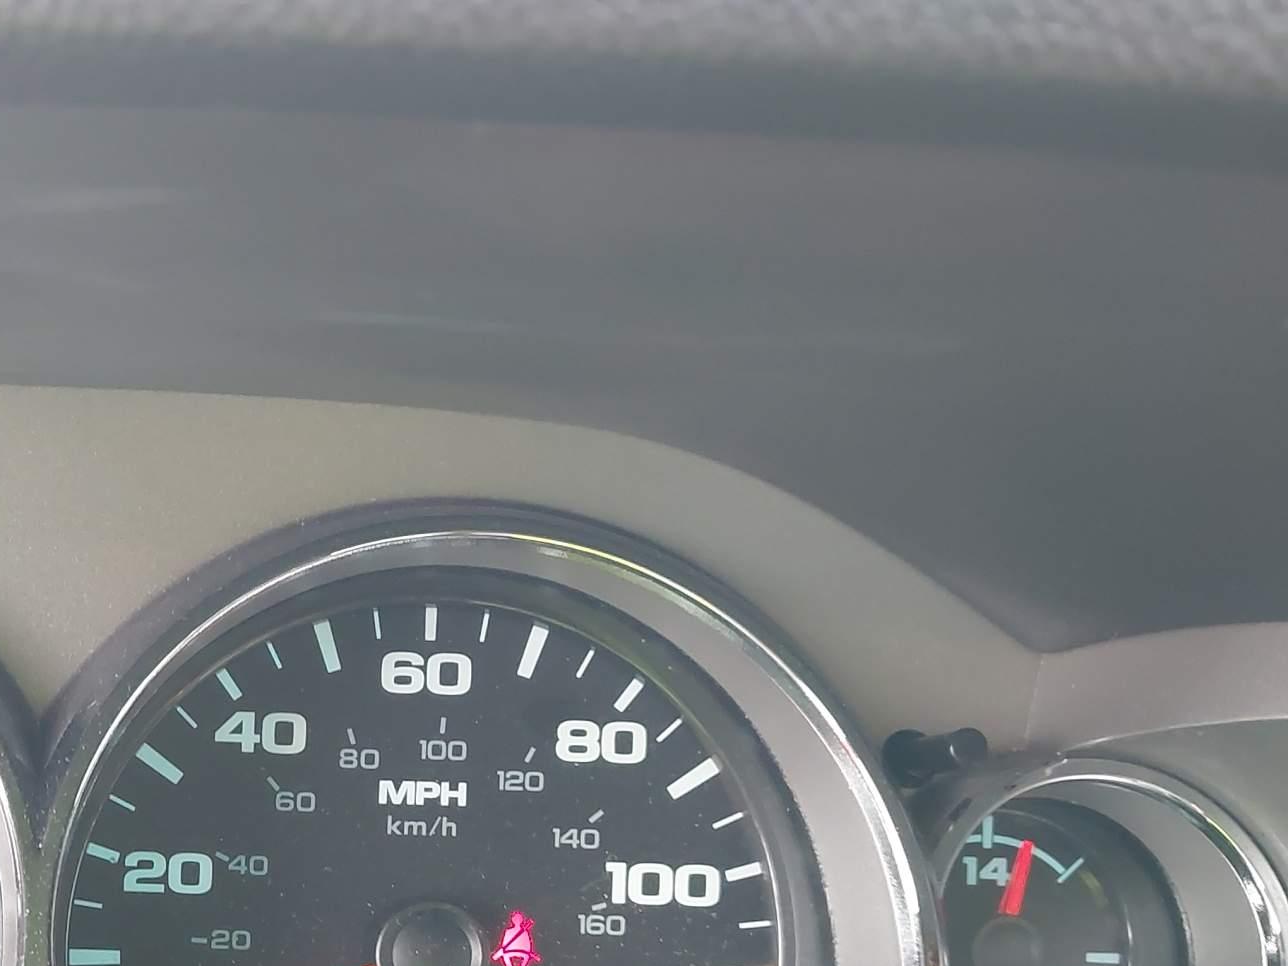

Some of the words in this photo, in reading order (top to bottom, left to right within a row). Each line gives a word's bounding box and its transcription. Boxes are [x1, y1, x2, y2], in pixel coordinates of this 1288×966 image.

[380, 651, 472, 696] 60
[214, 711, 308, 755] 40
[555, 720, 648, 764] 80
[339, 749, 380, 769] 80
[419, 739, 468, 761] 100
[497, 770, 545, 792] 120
[275, 792, 316, 812] 60
[378, 780, 467, 806] MPH
[386, 816, 457, 838] km/h
[553, 828, 601, 850] 140
[123, 851, 213, 894] 20
[228, 855, 269, 875] 40
[962, 856, 1012, 886] 14
[605, 862, 721, 907] 100
[578, 914, 626, 936] 160
